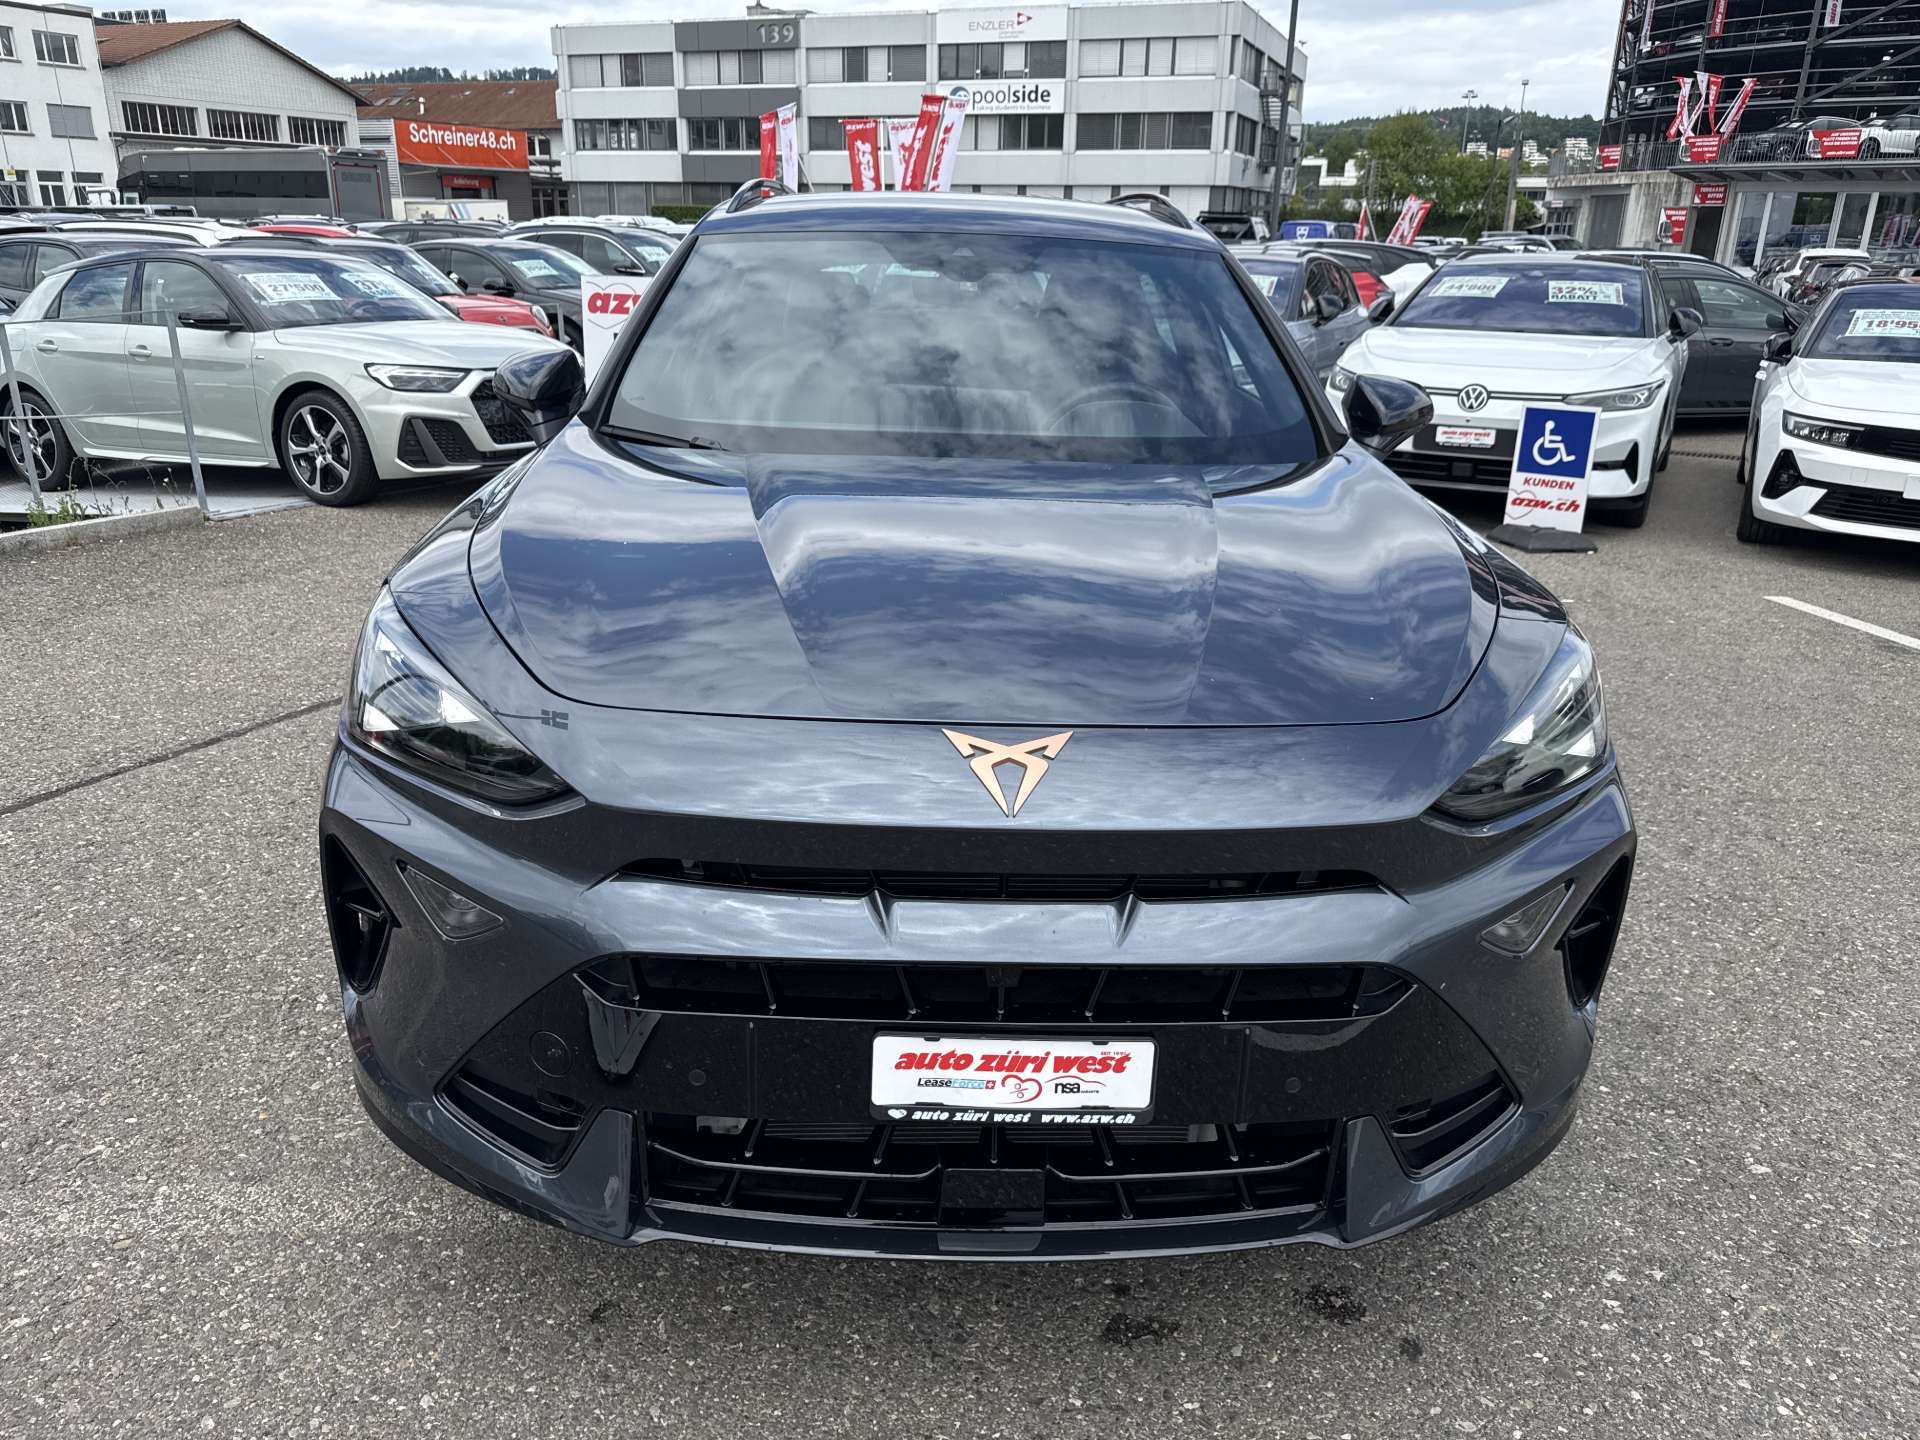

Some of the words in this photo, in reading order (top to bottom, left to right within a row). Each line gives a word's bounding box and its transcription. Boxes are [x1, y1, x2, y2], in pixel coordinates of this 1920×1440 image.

[756, 23, 795, 44] 139
[968, 20, 1015, 32] ENZLER
[972, 84, 1051, 111] poolside
[409, 123, 517, 151] Schreiner48.ch
[1866, 319, 1920, 329] 18'95
[1523, 476, 1575, 490] KUNDEN
[1511, 497, 1580, 513] azw.ch
[894, 1048, 974, 1071] auto
[974, 1050, 1051, 1073] züri
[1053, 1052, 1132, 1074] west
[1054, 1082, 1081, 1094] nsa
[911, 1110, 950, 1121] auto
[952, 1109, 990, 1122] züri
[993, 1112, 1032, 1123] west
[1041, 1113, 1136, 1125] www.azw.ch
